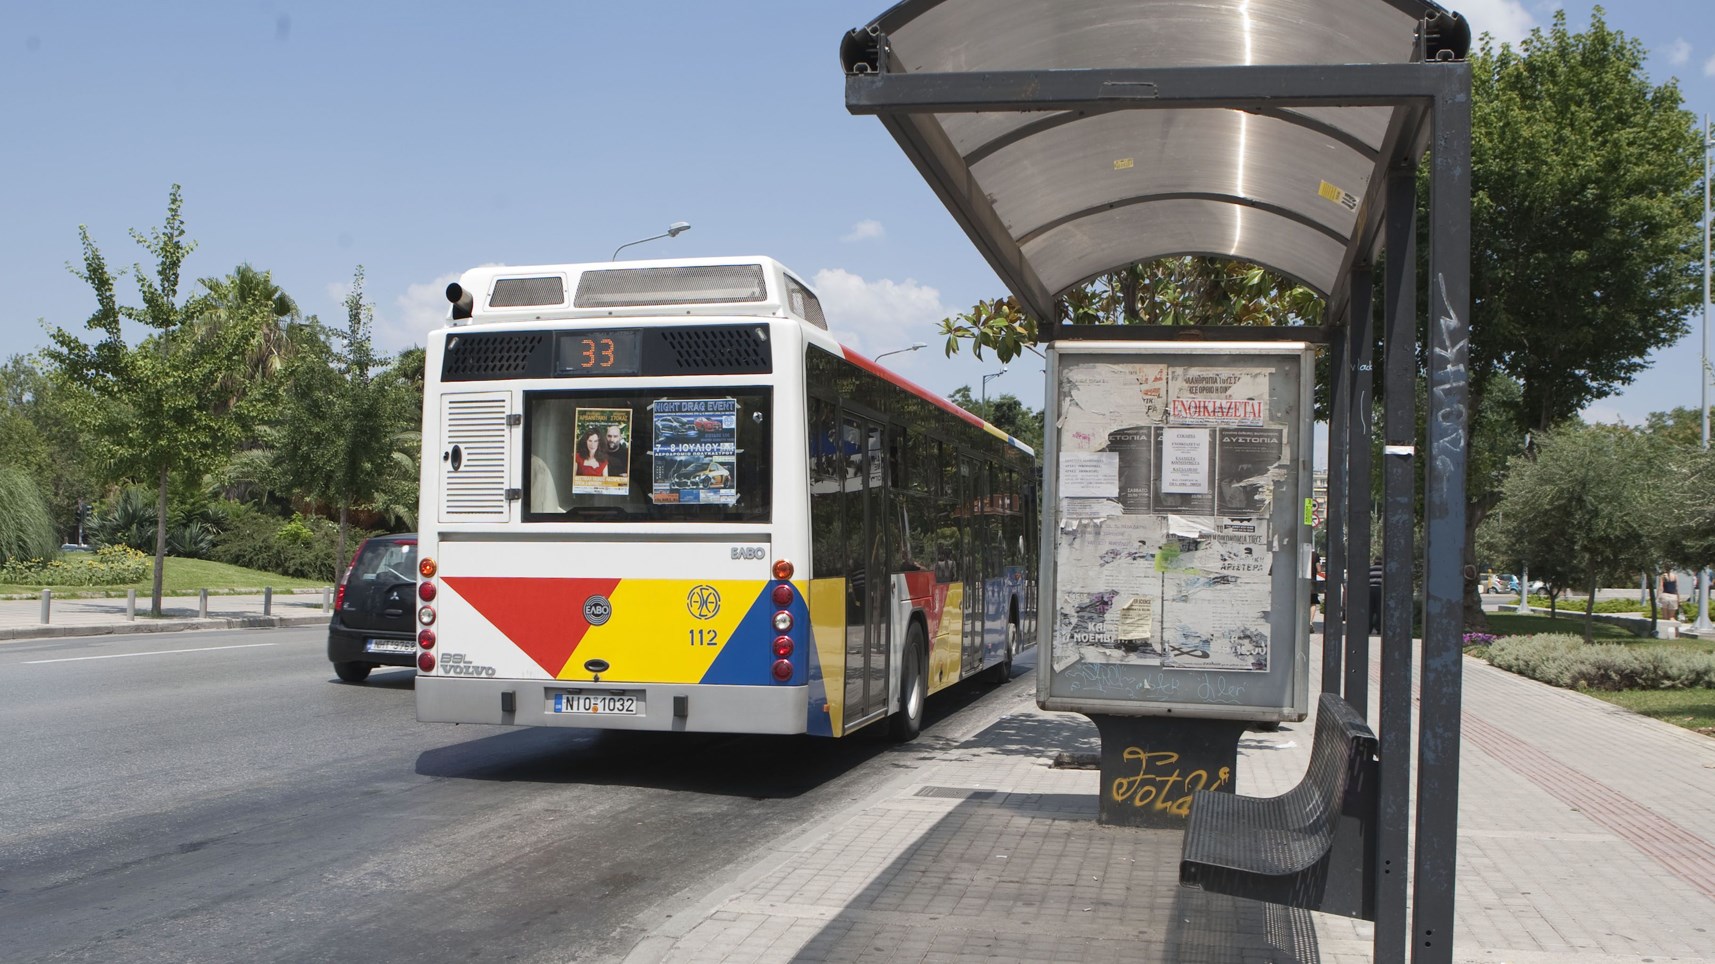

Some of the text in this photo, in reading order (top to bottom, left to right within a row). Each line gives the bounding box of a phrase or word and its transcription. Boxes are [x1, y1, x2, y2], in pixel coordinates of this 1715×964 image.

[579, 338, 615, 368] 33
[654, 401, 735, 412] NIGHT DRAG EVENT
[1172, 400, 1263, 418] ΕΝΟΙΚΙΑΖΕΤΑΙ
[655, 442, 718, 453] 7 8 ΙΟΥΛΙΟΥ
[730, 547, 766, 560] ΕΛΒΟ
[585, 605, 609, 615] ΕΛΒΟ
[689, 629, 718, 646] 112
[440, 664, 496, 677] VOLVO
